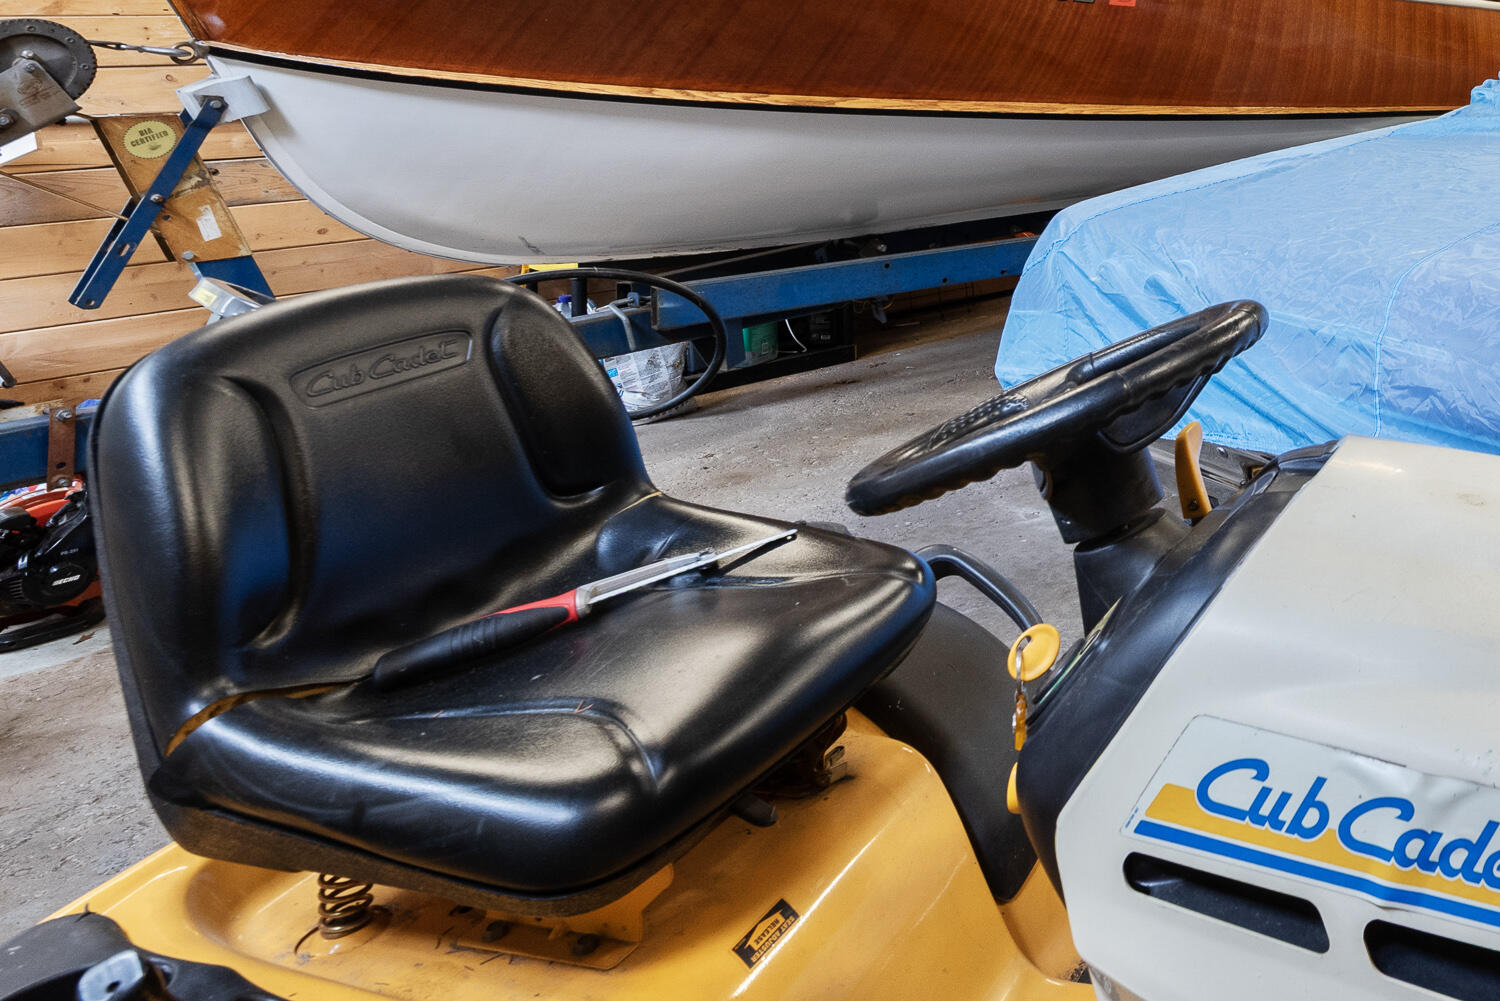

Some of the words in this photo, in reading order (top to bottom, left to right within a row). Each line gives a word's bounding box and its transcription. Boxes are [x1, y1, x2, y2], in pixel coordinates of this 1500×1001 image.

[130, 130, 169, 147] CERTIFIED
[306, 363, 366, 398] Cub
[369, 338, 457, 380] Cadet
[1196, 756, 1332, 841] Cub
[752, 917, 780, 945] RELEASE
